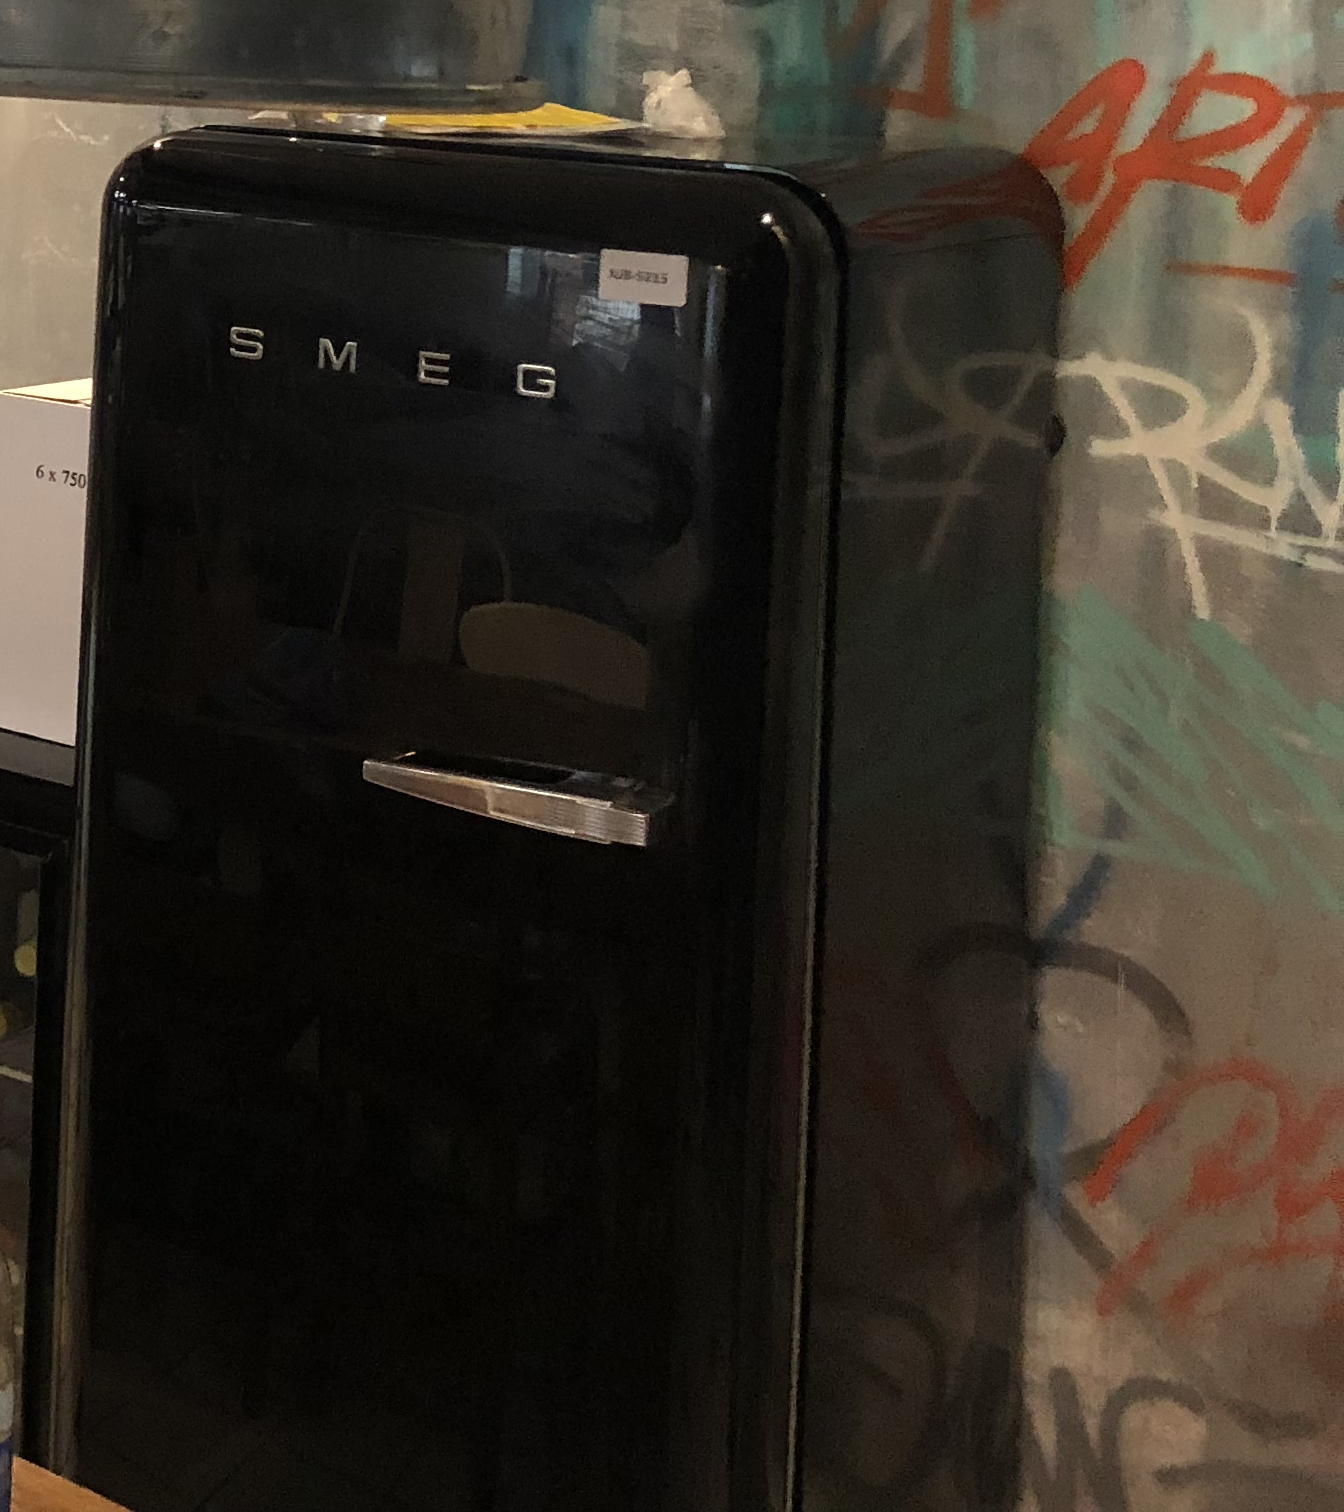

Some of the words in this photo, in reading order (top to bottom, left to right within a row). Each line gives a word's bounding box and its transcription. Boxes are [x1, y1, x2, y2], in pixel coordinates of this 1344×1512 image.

[229, 325, 556, 399] SMEG
[35, 464, 45, 479] 6
[48, 471, 57, 483] x
[61, 469, 86, 489] 750
